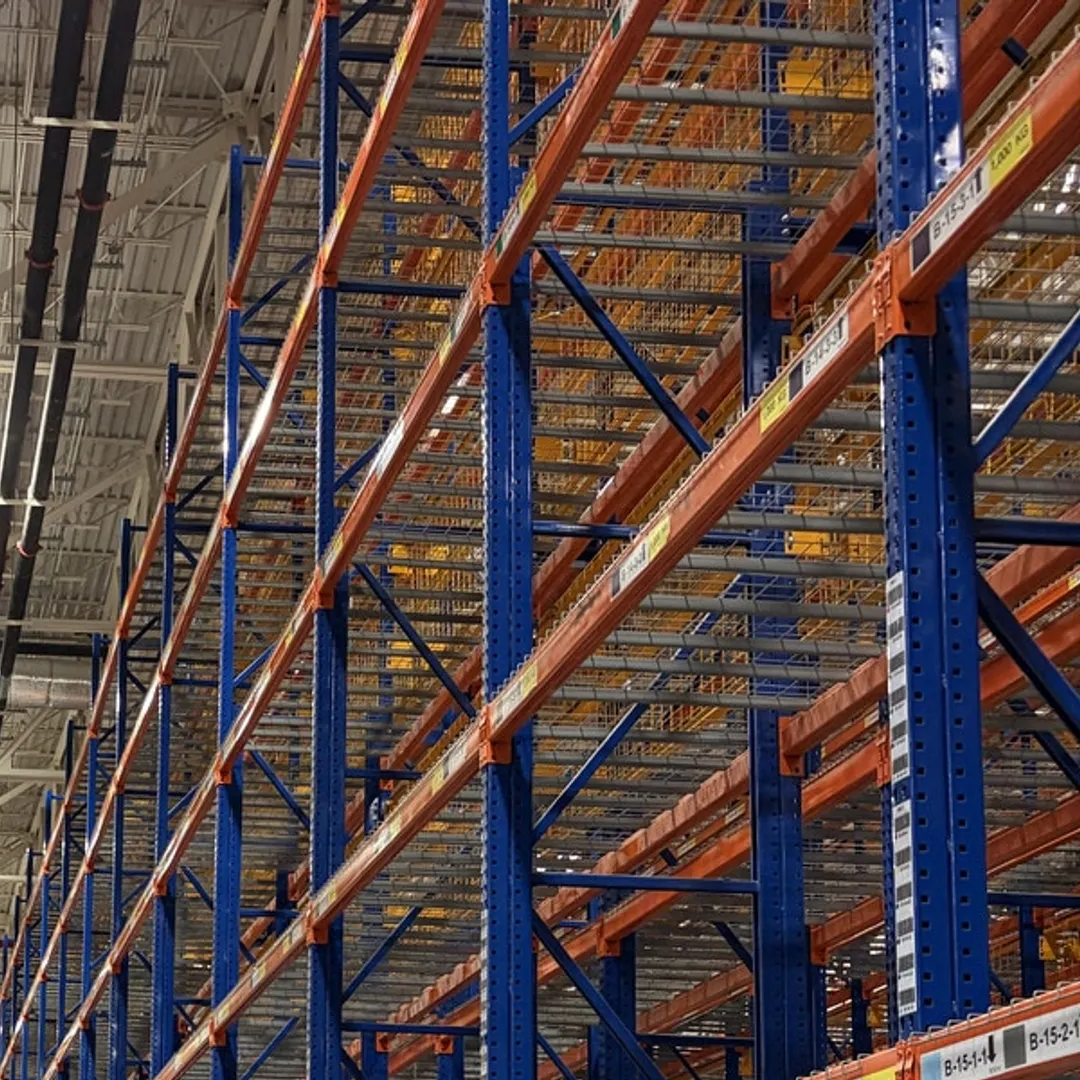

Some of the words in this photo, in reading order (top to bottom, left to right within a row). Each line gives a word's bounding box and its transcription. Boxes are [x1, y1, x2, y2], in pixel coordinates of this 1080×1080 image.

[932, 181, 976, 240] B-15-3-1
[1029, 1019, 1080, 1051] B-15-2-1
[945, 1047, 987, 1077] B-15-1-1
